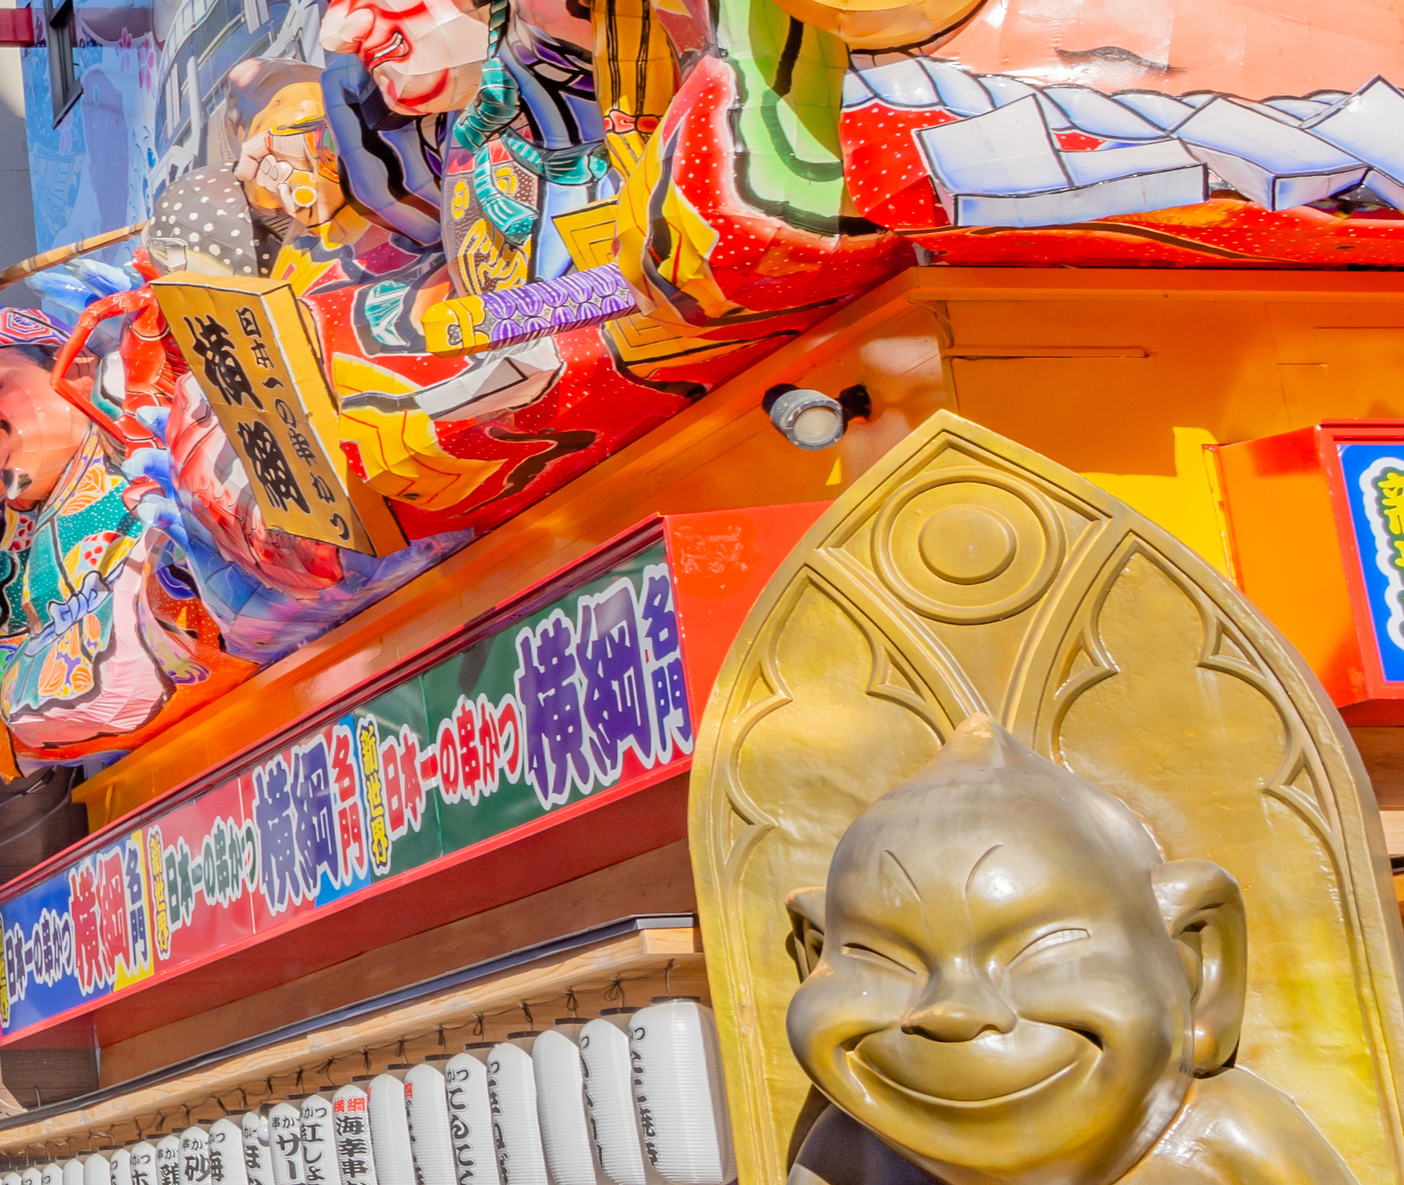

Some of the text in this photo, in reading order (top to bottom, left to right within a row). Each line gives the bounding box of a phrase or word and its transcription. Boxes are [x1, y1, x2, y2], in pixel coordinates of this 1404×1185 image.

[183, 314, 310, 513] 横綱
[518, 584, 651, 801] 横綱
[255, 740, 339, 908] 横綱
[271, 1116, 301, 1129] 串か
